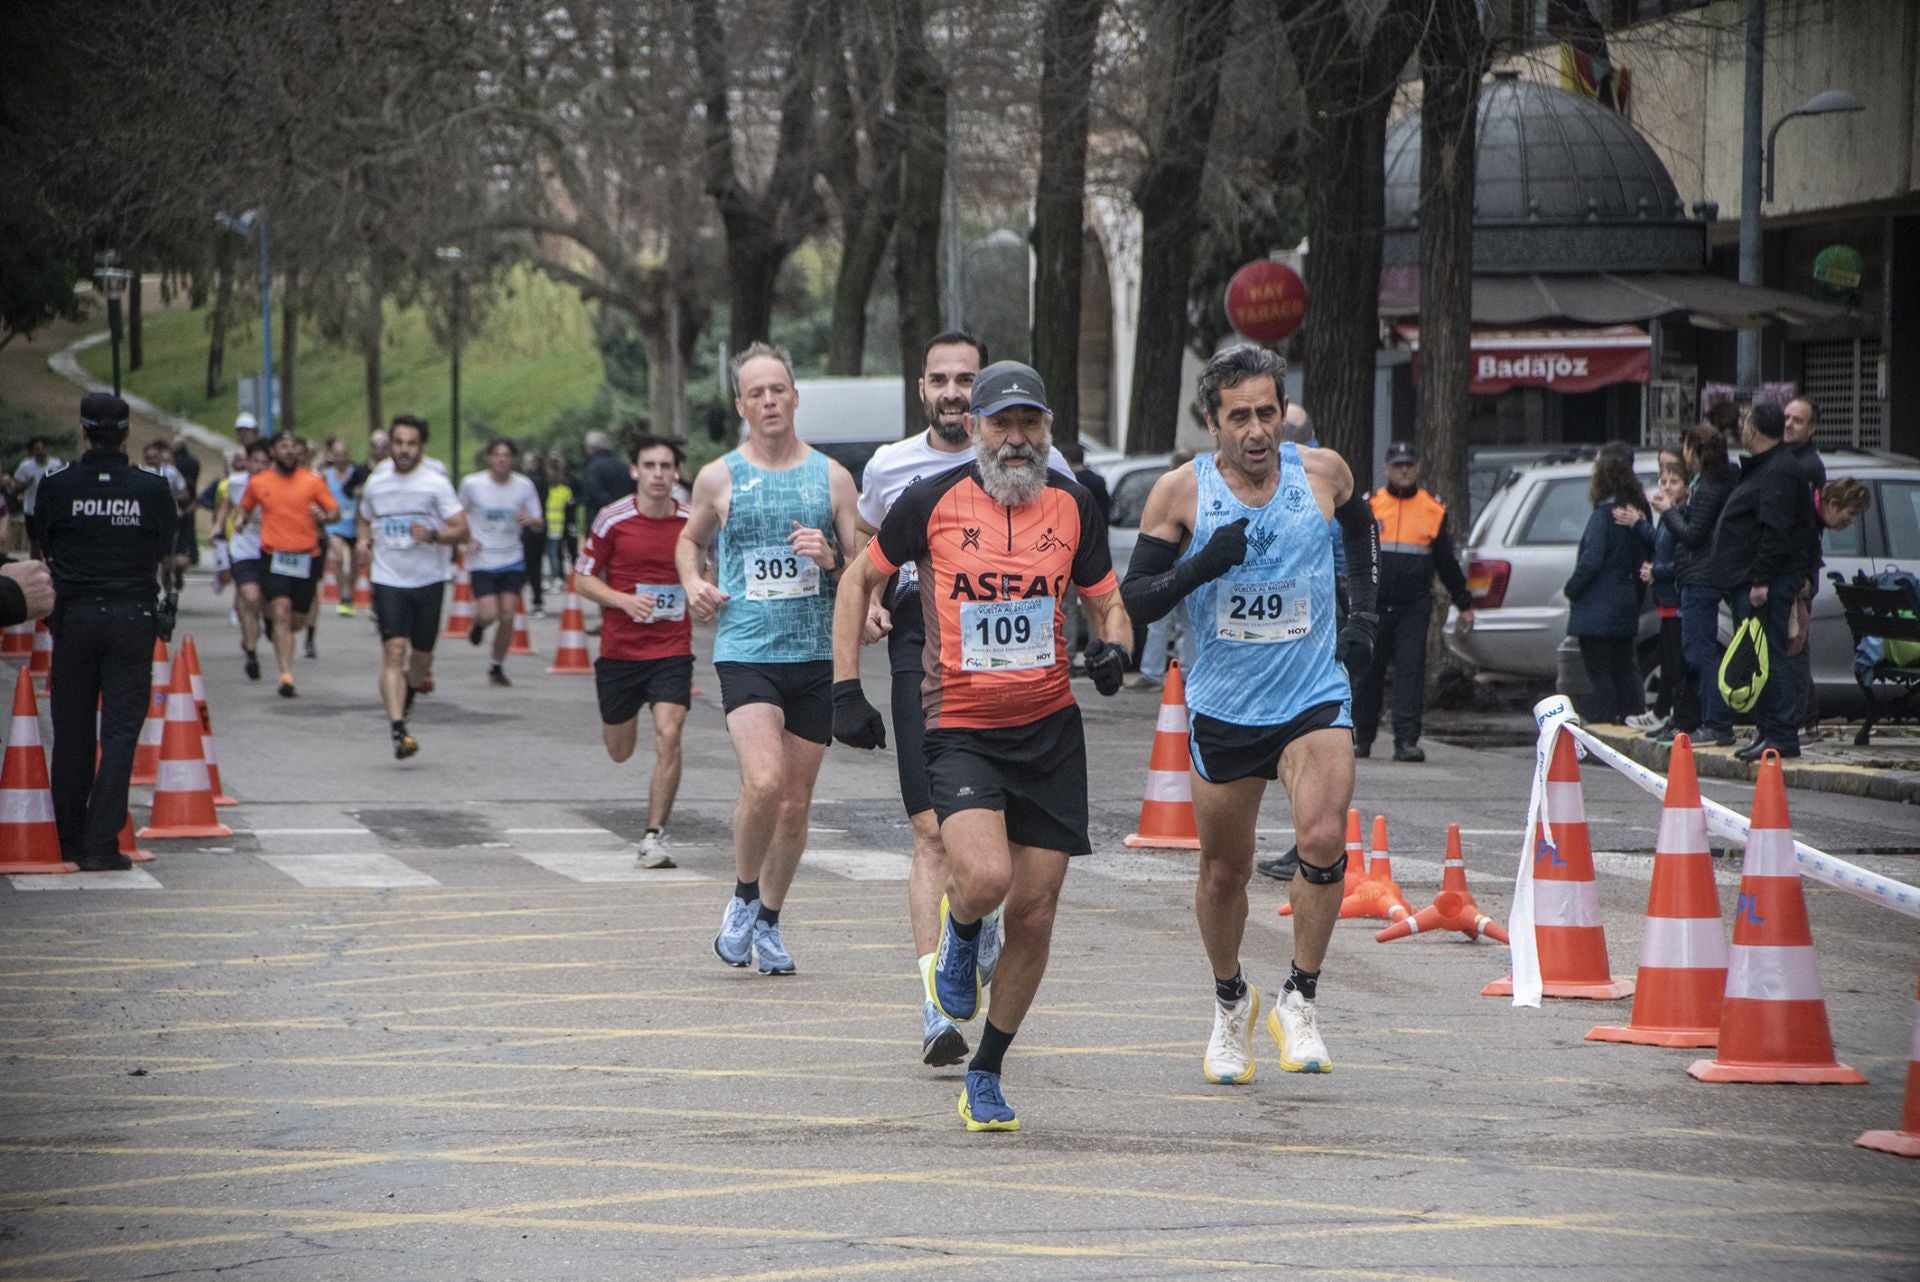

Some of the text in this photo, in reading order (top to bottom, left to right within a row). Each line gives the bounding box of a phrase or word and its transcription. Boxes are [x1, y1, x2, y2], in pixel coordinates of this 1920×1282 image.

[1477, 355, 1588, 382] Badajoz
[72, 499, 141, 516] POLICIA
[111, 516, 141, 526] LOCAL
[755, 557, 798, 580] 303
[656, 593, 676, 609] 62
[1230, 593, 1283, 620] 249
[976, 615, 1031, 645] 109
[1288, 627, 1307, 635] HOY
[1036, 653, 1051, 661] HOY
[1537, 839, 1568, 866] PL
[1737, 893, 1765, 925] PL
